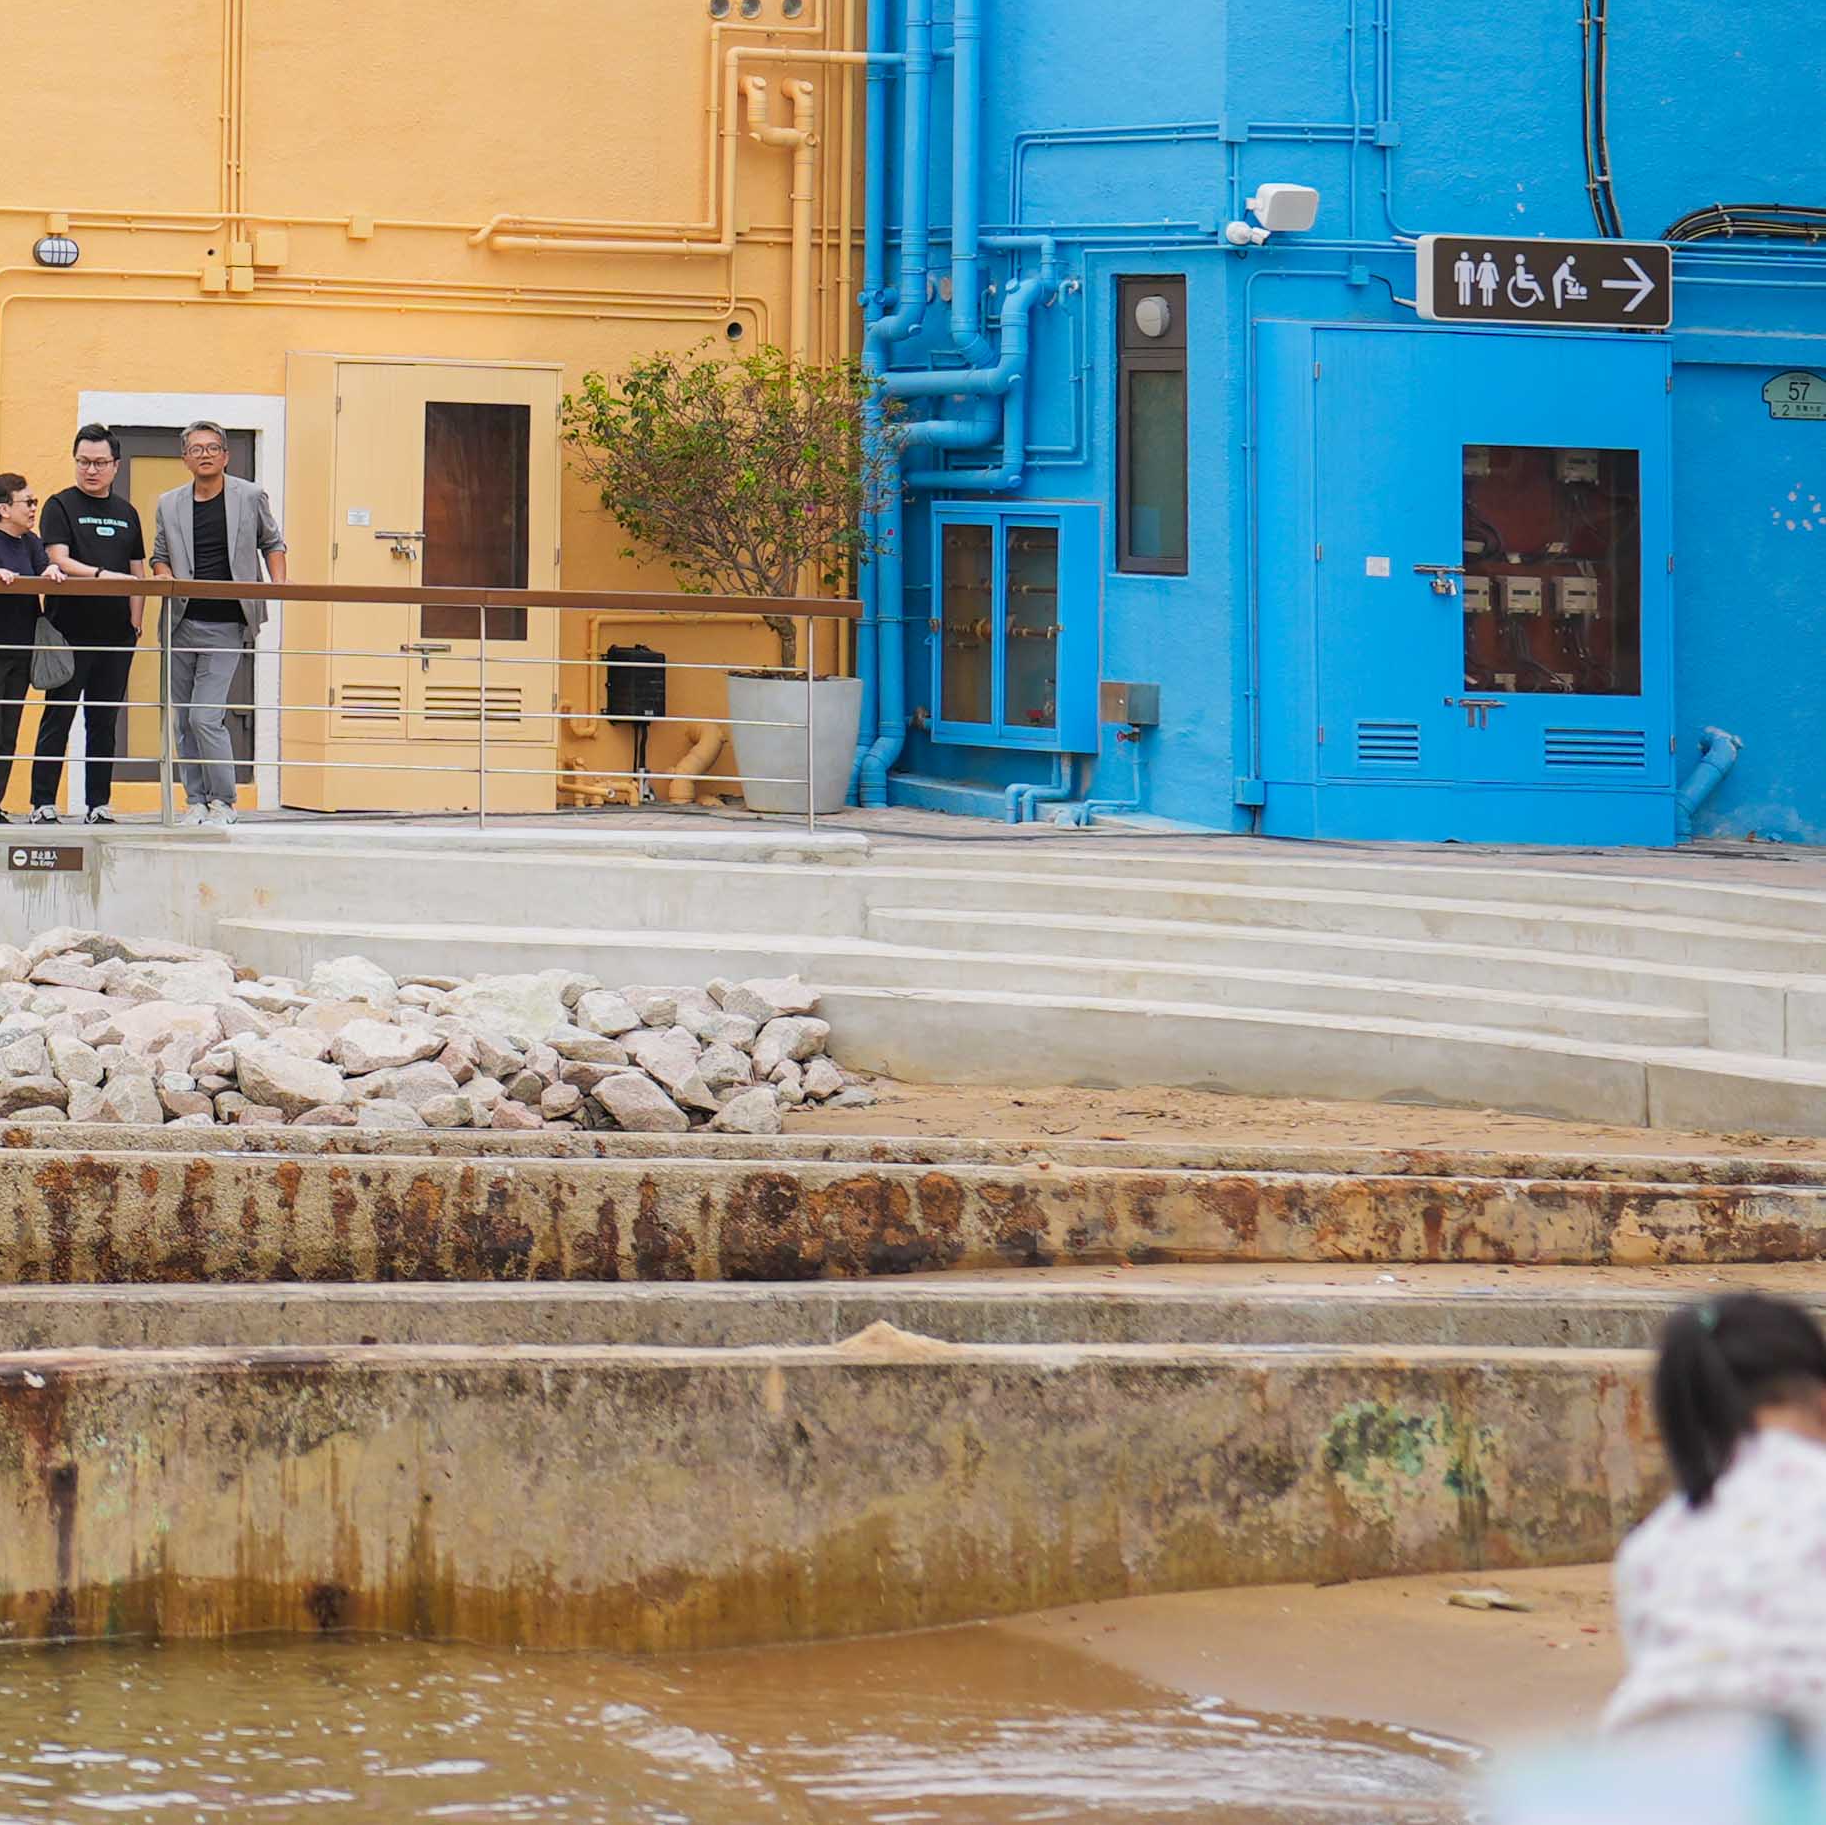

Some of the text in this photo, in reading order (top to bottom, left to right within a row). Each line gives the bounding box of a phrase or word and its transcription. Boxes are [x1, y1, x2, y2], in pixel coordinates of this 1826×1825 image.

[1788, 381, 1811, 401] 57
[1781, 404, 1790, 416] 2
[40, 859, 55, 868] Entry
